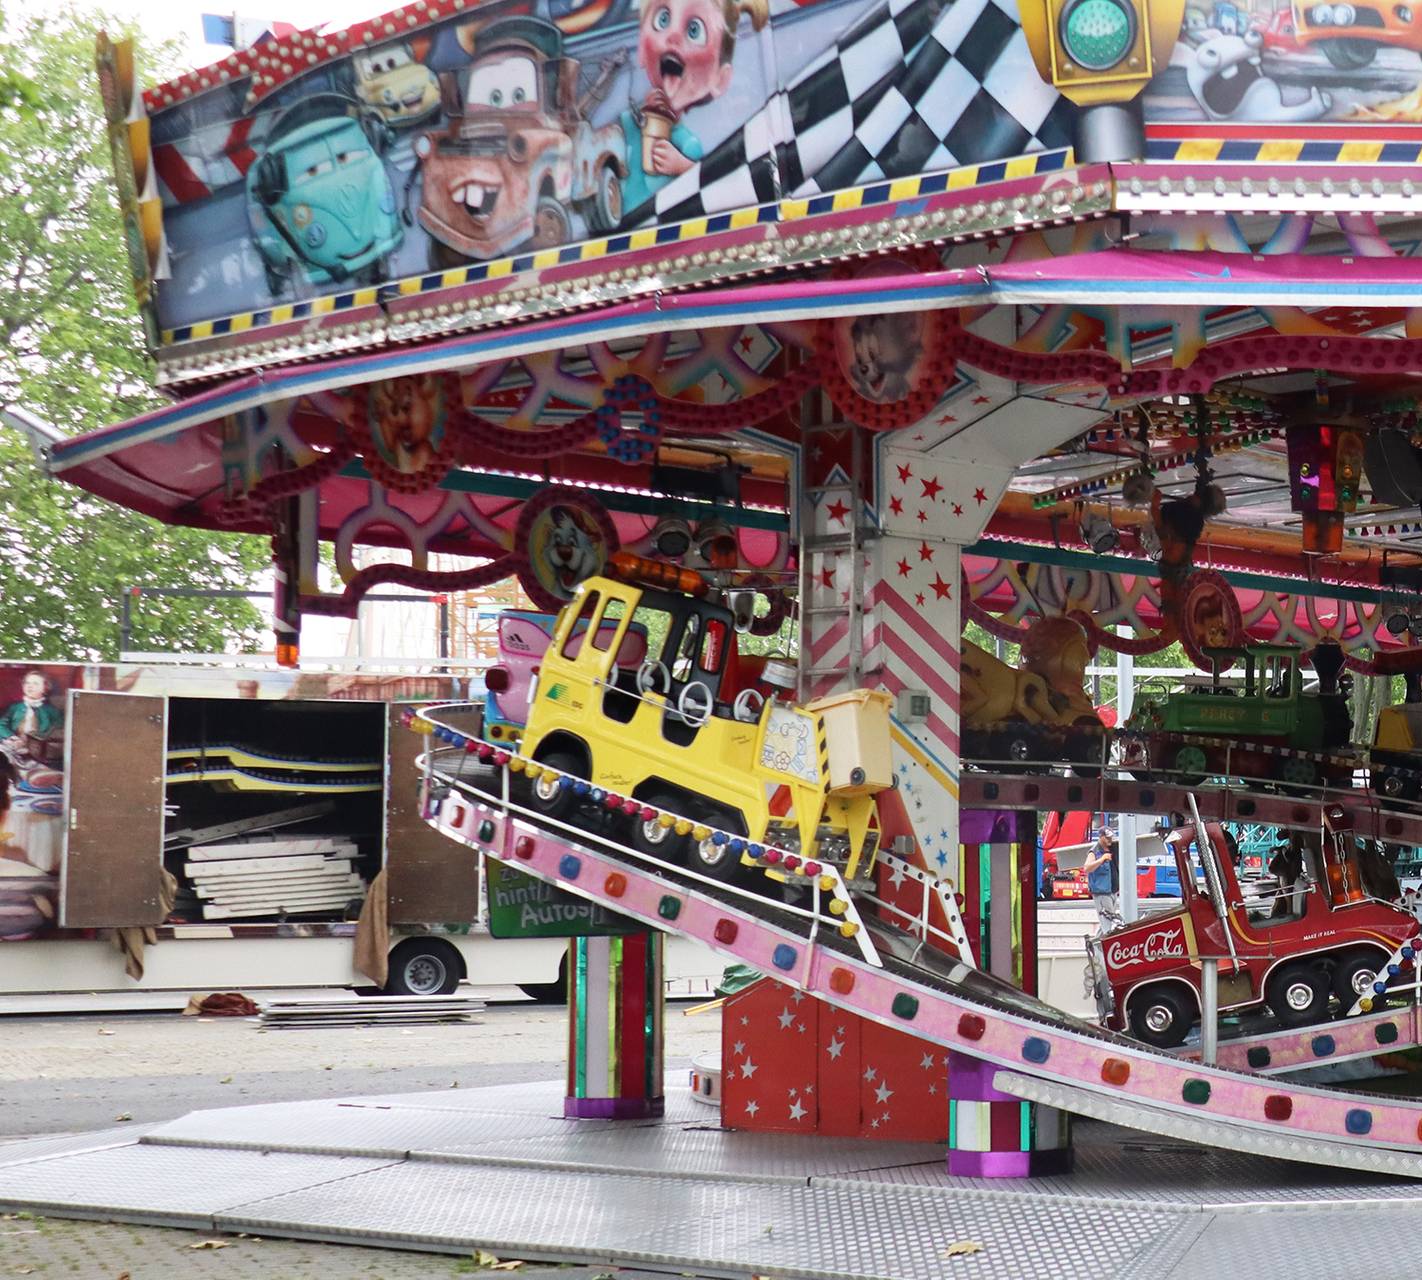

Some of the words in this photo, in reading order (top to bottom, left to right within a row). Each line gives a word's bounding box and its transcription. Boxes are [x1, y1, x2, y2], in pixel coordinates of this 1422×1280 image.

[1107, 927, 1184, 970] Coca-Cola
[1303, 932, 1317, 942] MAKE
[1323, 929, 1336, 937] REAL
